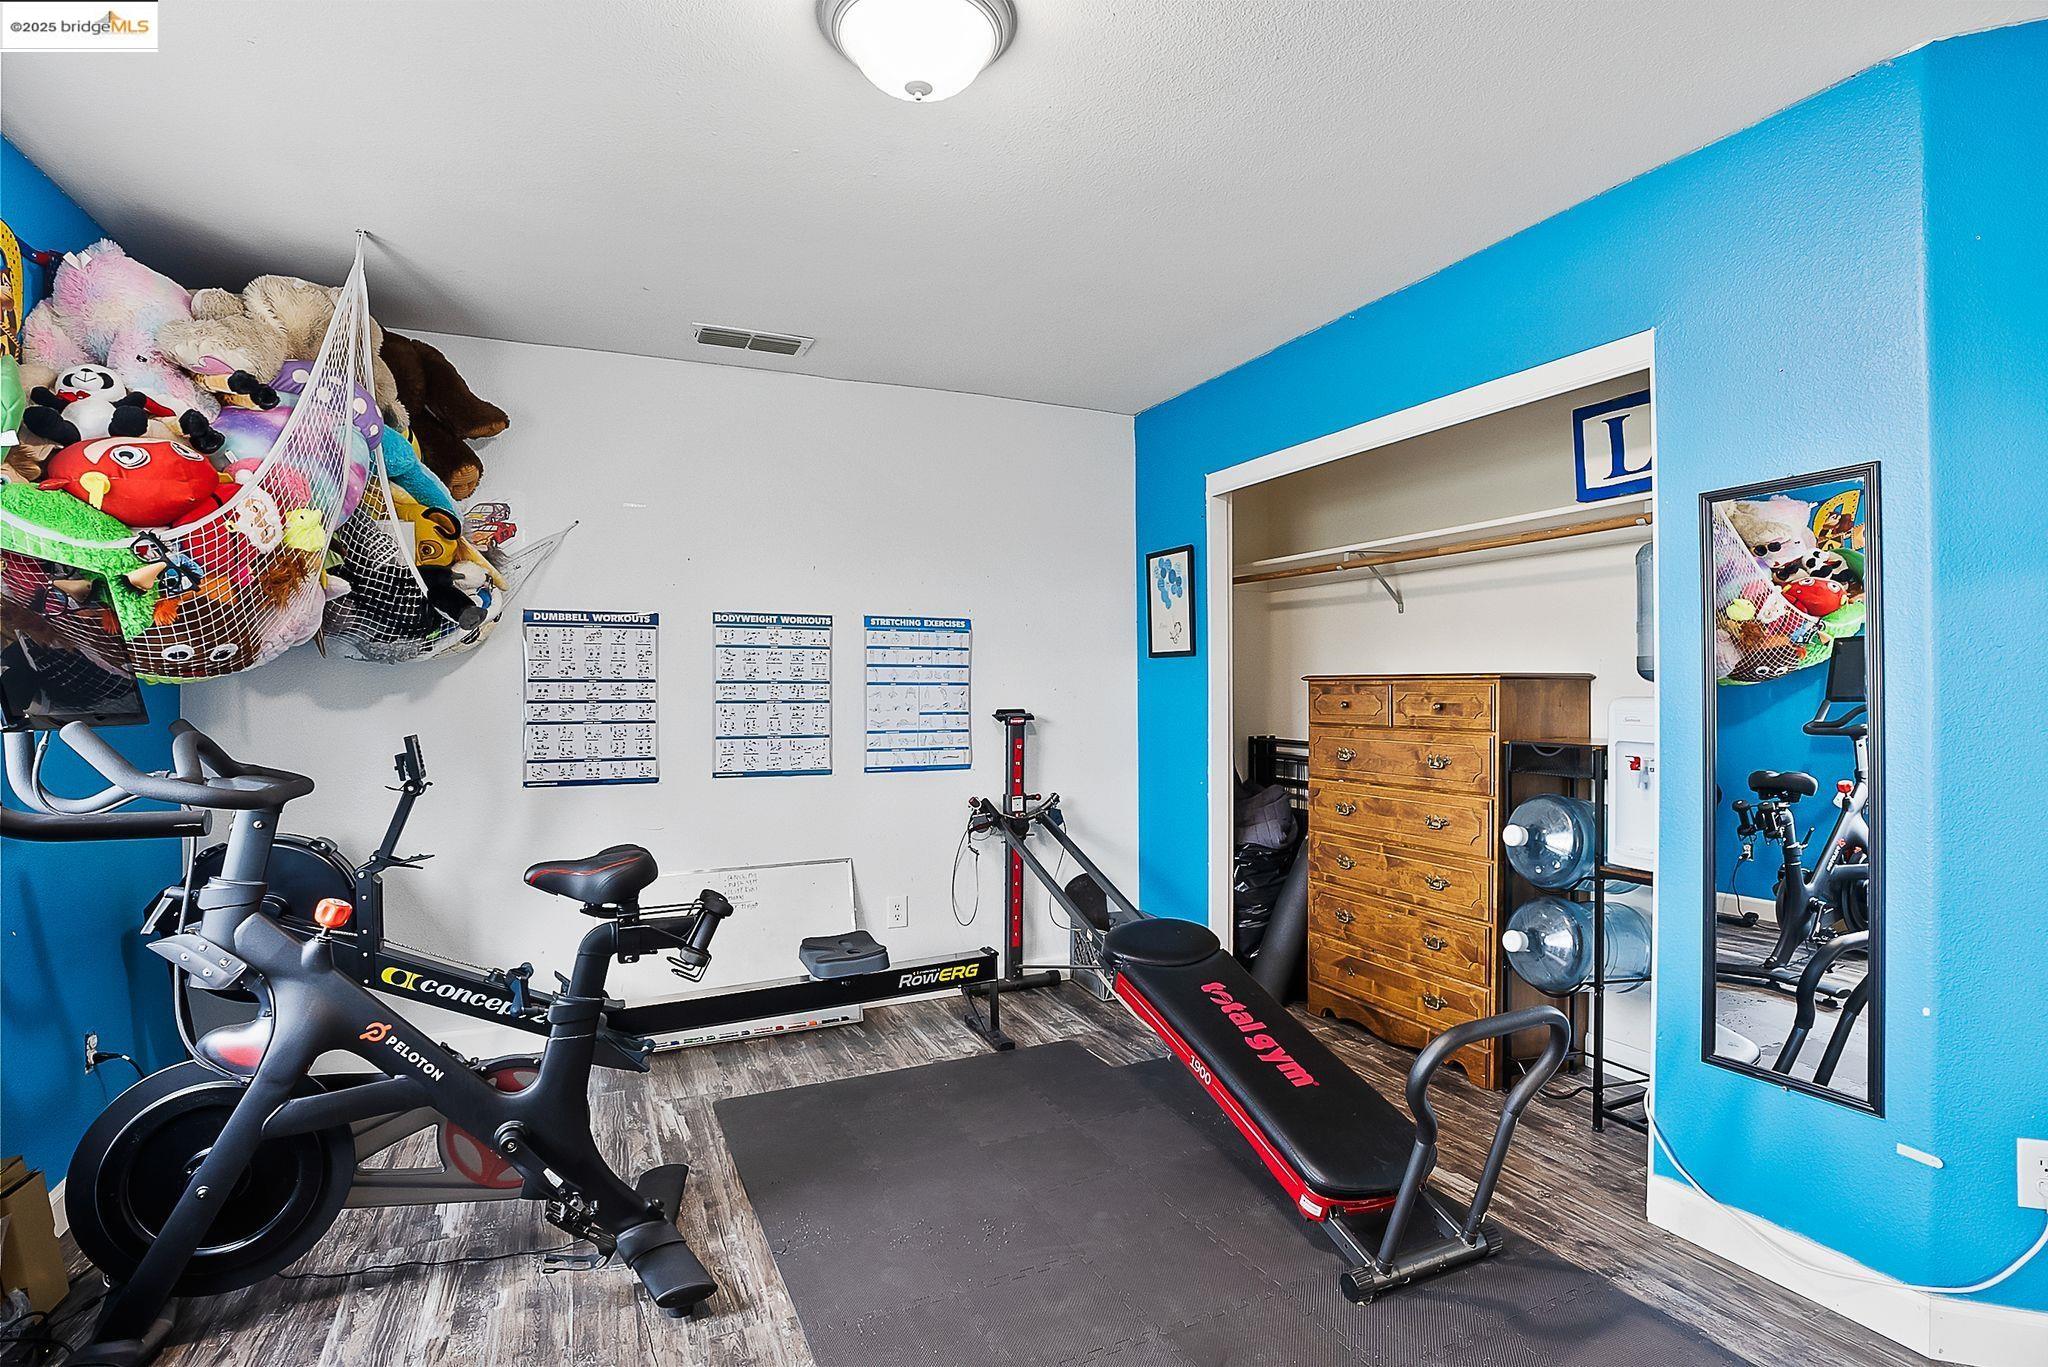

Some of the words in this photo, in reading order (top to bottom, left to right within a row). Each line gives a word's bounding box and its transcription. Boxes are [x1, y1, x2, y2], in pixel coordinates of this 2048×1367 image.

[533, 612, 590, 621] DUMBBELL
[592, 613, 651, 623] WORKOUTS
[715, 614, 778, 623] BODYWEIGHT
[781, 616, 831, 625] WORKOUTS
[870, 618, 921, 627] STRETCHING
[924, 619, 966, 628] EXERCISES
[420, 979, 526, 1018] concep
[1201, 981, 1267, 1033] total
[1244, 1033, 1314, 1087] gym
[385, 1035, 445, 1082] PELOTON
[1189, 1055, 1212, 1085] 1900
